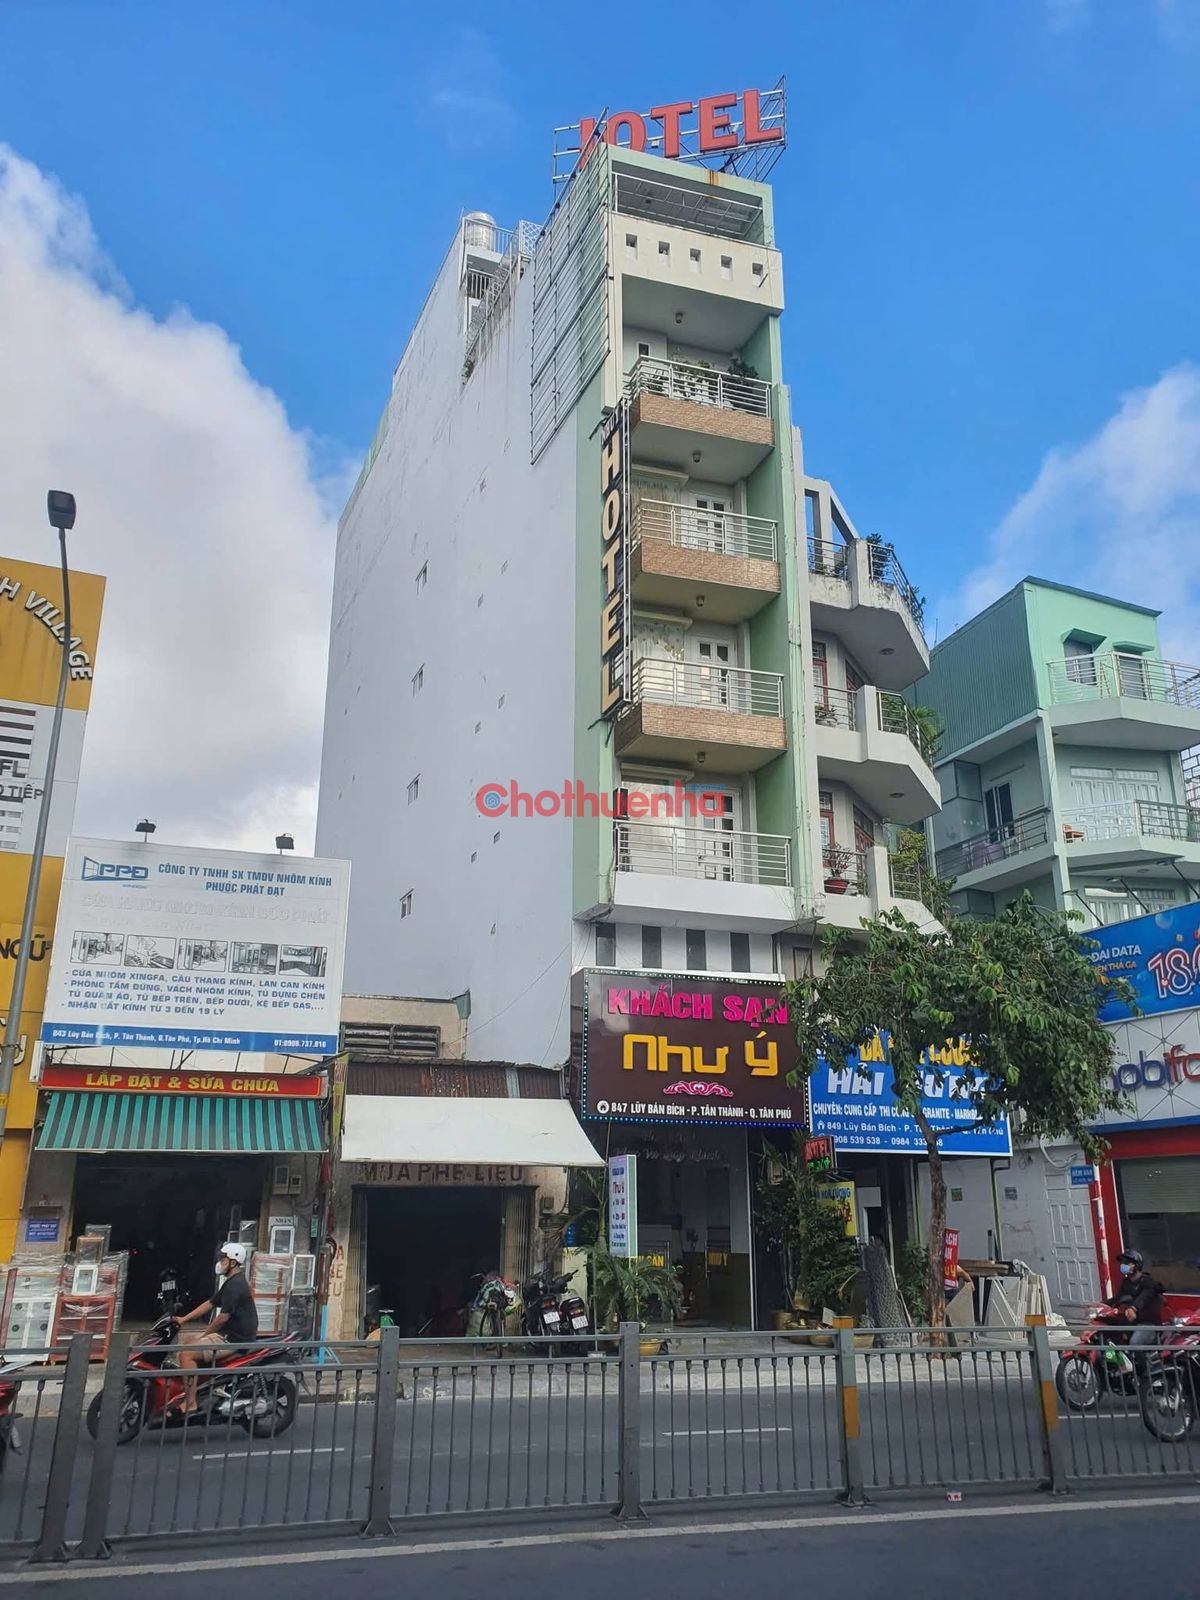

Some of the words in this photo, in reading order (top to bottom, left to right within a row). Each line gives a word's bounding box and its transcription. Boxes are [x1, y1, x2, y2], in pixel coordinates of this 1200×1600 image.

[601, 430, 620, 714] HOTEL
[25, 590, 93, 680] VILLAGE
[158, 863, 185, 876] CÔNG
[189, 866, 200, 876] TY
[203, 867, 228, 878] TNHH
[232, 870, 244, 879] SX
[276, 872, 306, 884] NHÔM
[308, 874, 332, 886] KÍNH
[205, 880, 238, 893] PHƯỚC
[240, 882, 264, 895] PHÁT
[266, 886, 286, 897] ĐẠT
[1111, 944, 1142, 958] DATA
[194, 976, 226, 985] THANG
[280, 980, 300, 988] CAN
[302, 981, 325, 990] KÍNH
[122, 1002, 146, 1012] KÍNH
[608, 984, 713, 1020] KHÁCH
[723, 995, 788, 1028] SẠN
[1112, 1044, 1200, 1092] obifo
[85, 1070, 123, 1086] LẮP
[128, 1072, 162, 1090] ĐẶT
[168, 1077, 182, 1089] &
[188, 1074, 225, 1091] SỬA
[231, 1076, 280, 1092] CHỮA
[611, 1102, 628, 1113] 847
[630, 1102, 646, 1114] LŨY
[648, 1102, 664, 1115] BÁN
[666, 1103, 685, 1116] BÍCH
[718, 1106, 744, 1118] THÀNH
[776, 1108, 792, 1119] PHÚ
[844, 1104, 862, 1116] CUNG
[863, 1102, 877, 1116] CẤP
[879, 1105, 890, 1116] THI
[922, 1106, 950, 1119] GRANITE
[826, 1121, 842, 1130] 849
[861, 1122, 876, 1132] Bán
[879, 1122, 896, 1132] Bích
[904, 1124, 912, 1132] P.
[850, 1136, 864, 1144] 539
[866, 1136, 880, 1145] 538
[891, 1137, 910, 1146] 0984
